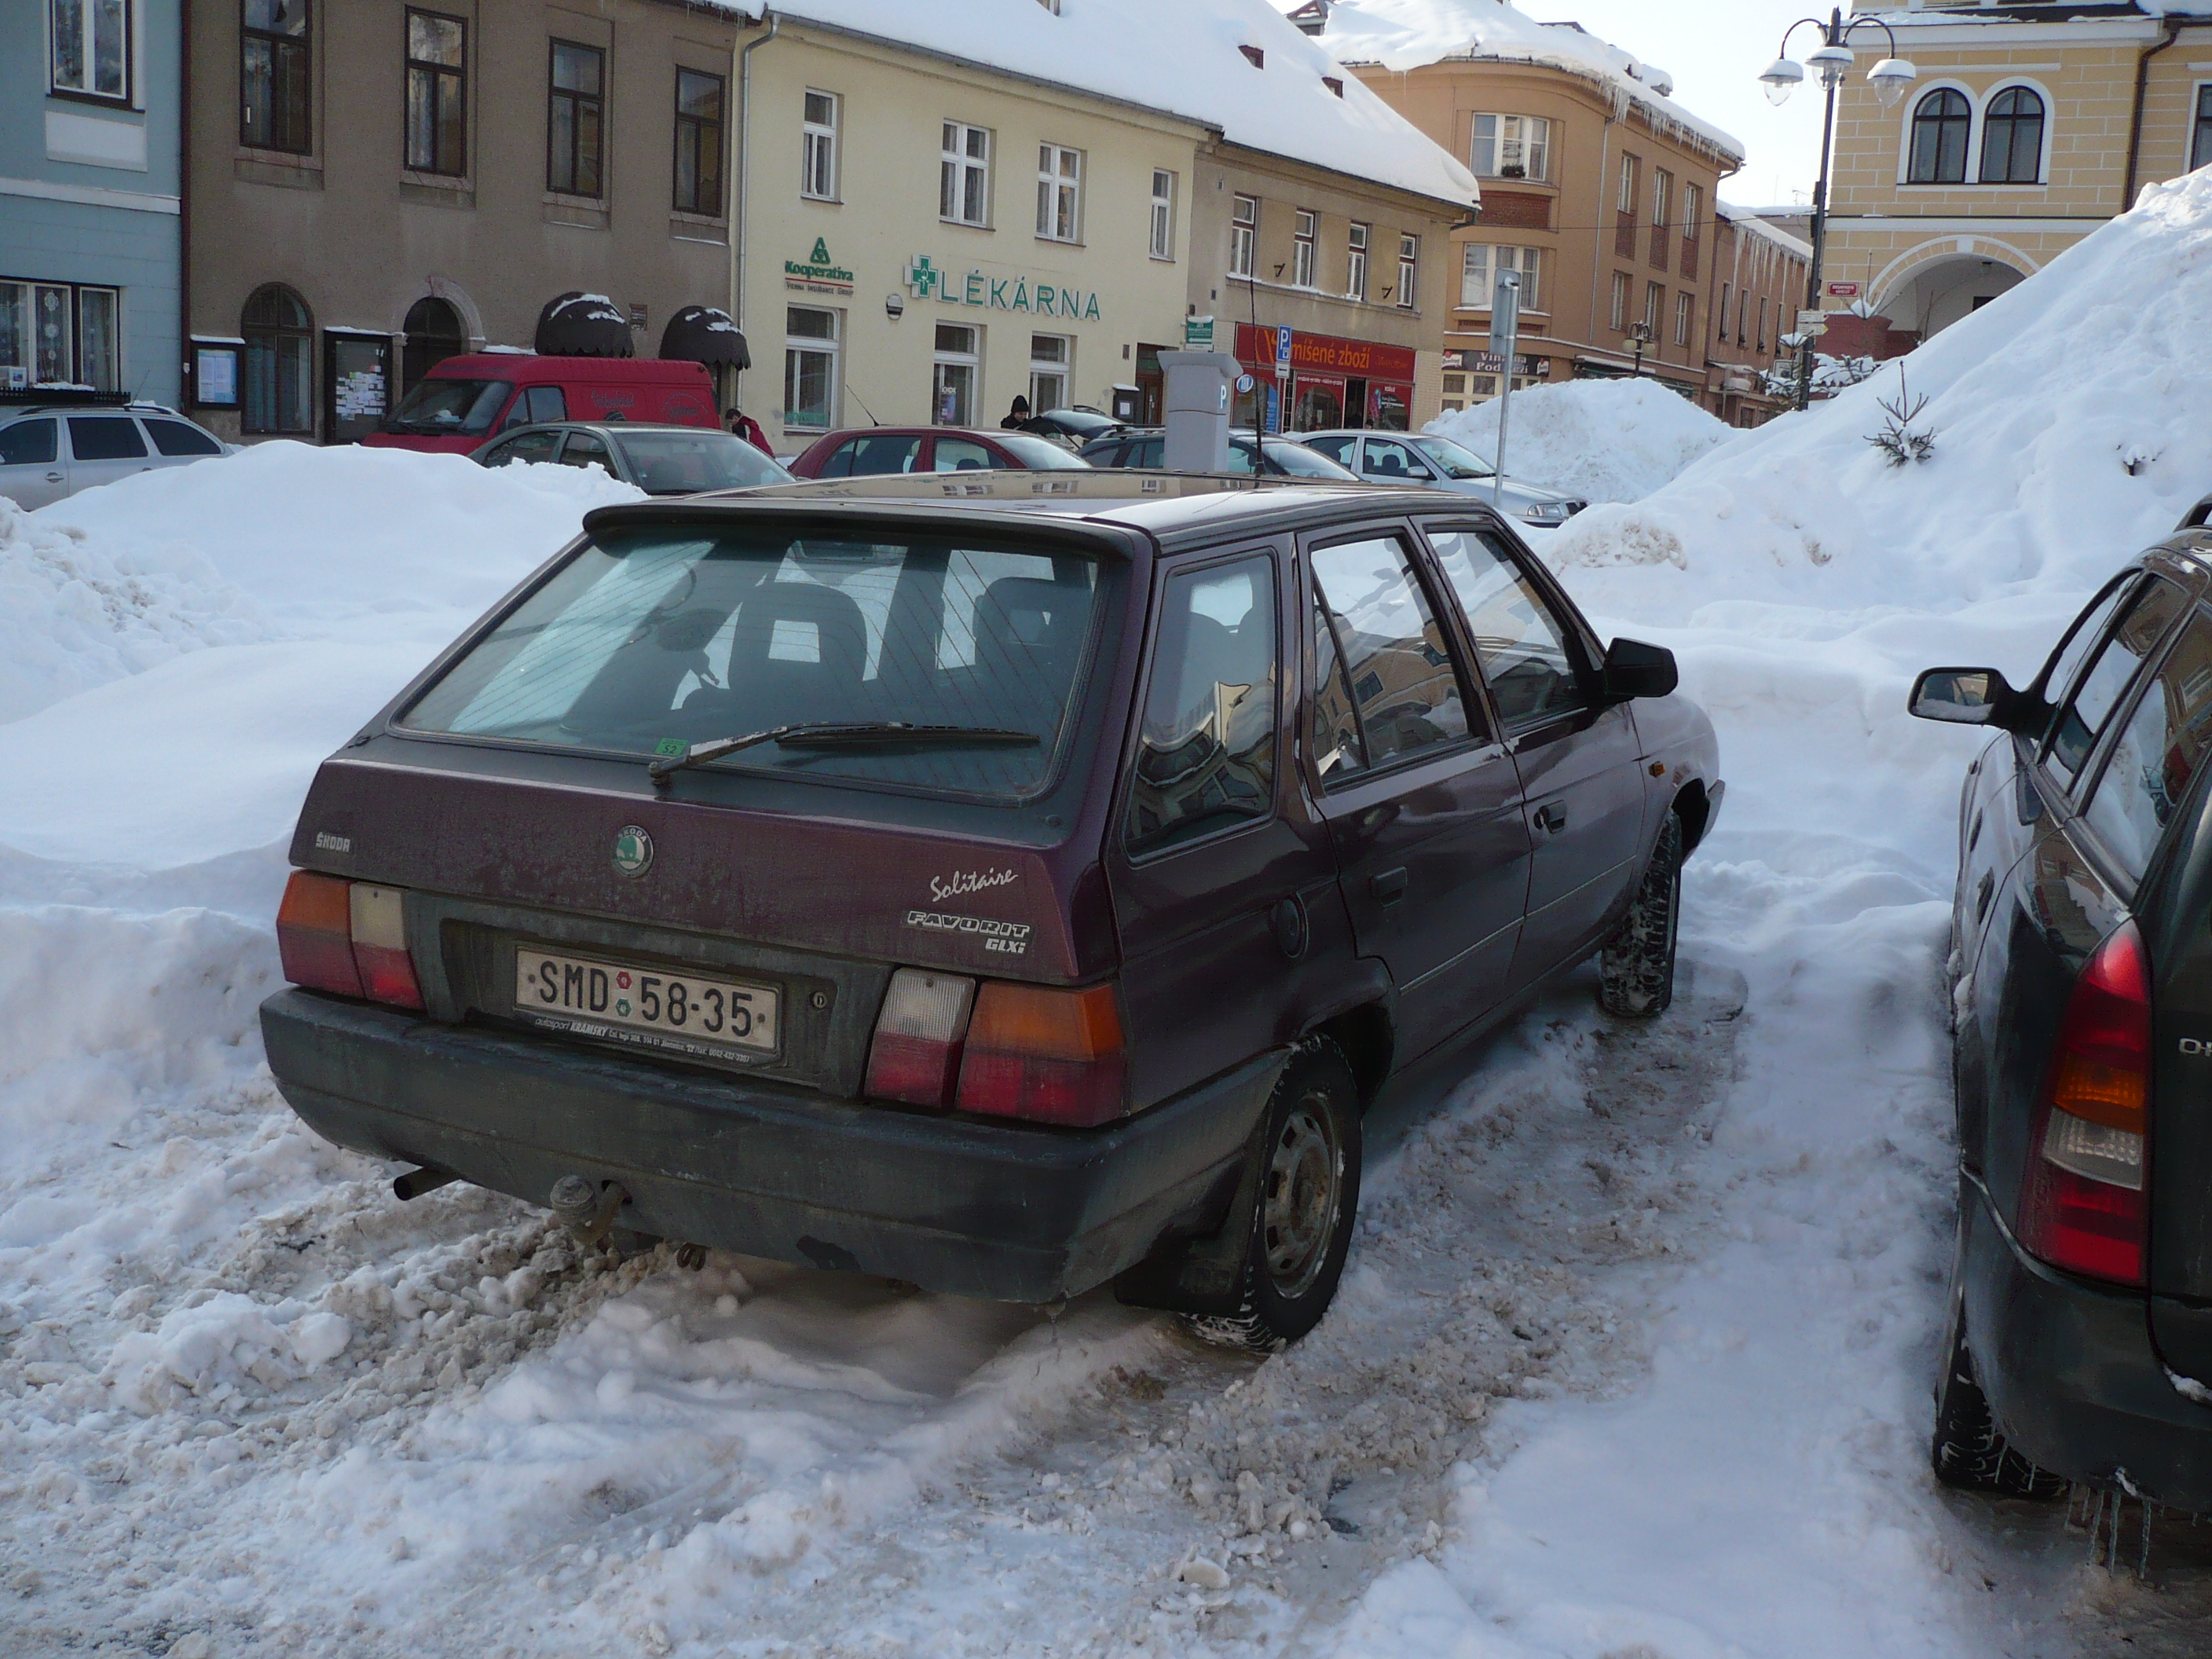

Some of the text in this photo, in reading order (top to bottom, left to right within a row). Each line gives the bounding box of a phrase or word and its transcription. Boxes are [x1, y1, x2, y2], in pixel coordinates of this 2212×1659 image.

[785, 260, 854, 281] Kooperativa
[938, 269, 1101, 320] LÉKÁRNA
[1280, 329, 1289, 350] P
[1291, 338, 1335, 365] míšené
[1338, 346, 1371, 369] zboží
[1481, 352, 1527, 364] Vinna
[1476, 361, 1501, 372] Pod
[1220, 385, 1227, 409] P
[316, 831, 351, 853] ŠKODA
[930, 867, 1019, 903] Solitaire
[906, 910, 1031, 939] FAVORIT
[985, 938, 1026, 954] GLXi
[539, 960, 753, 1037] SMD 58-35
[535, 1017, 570, 1031] autosport
